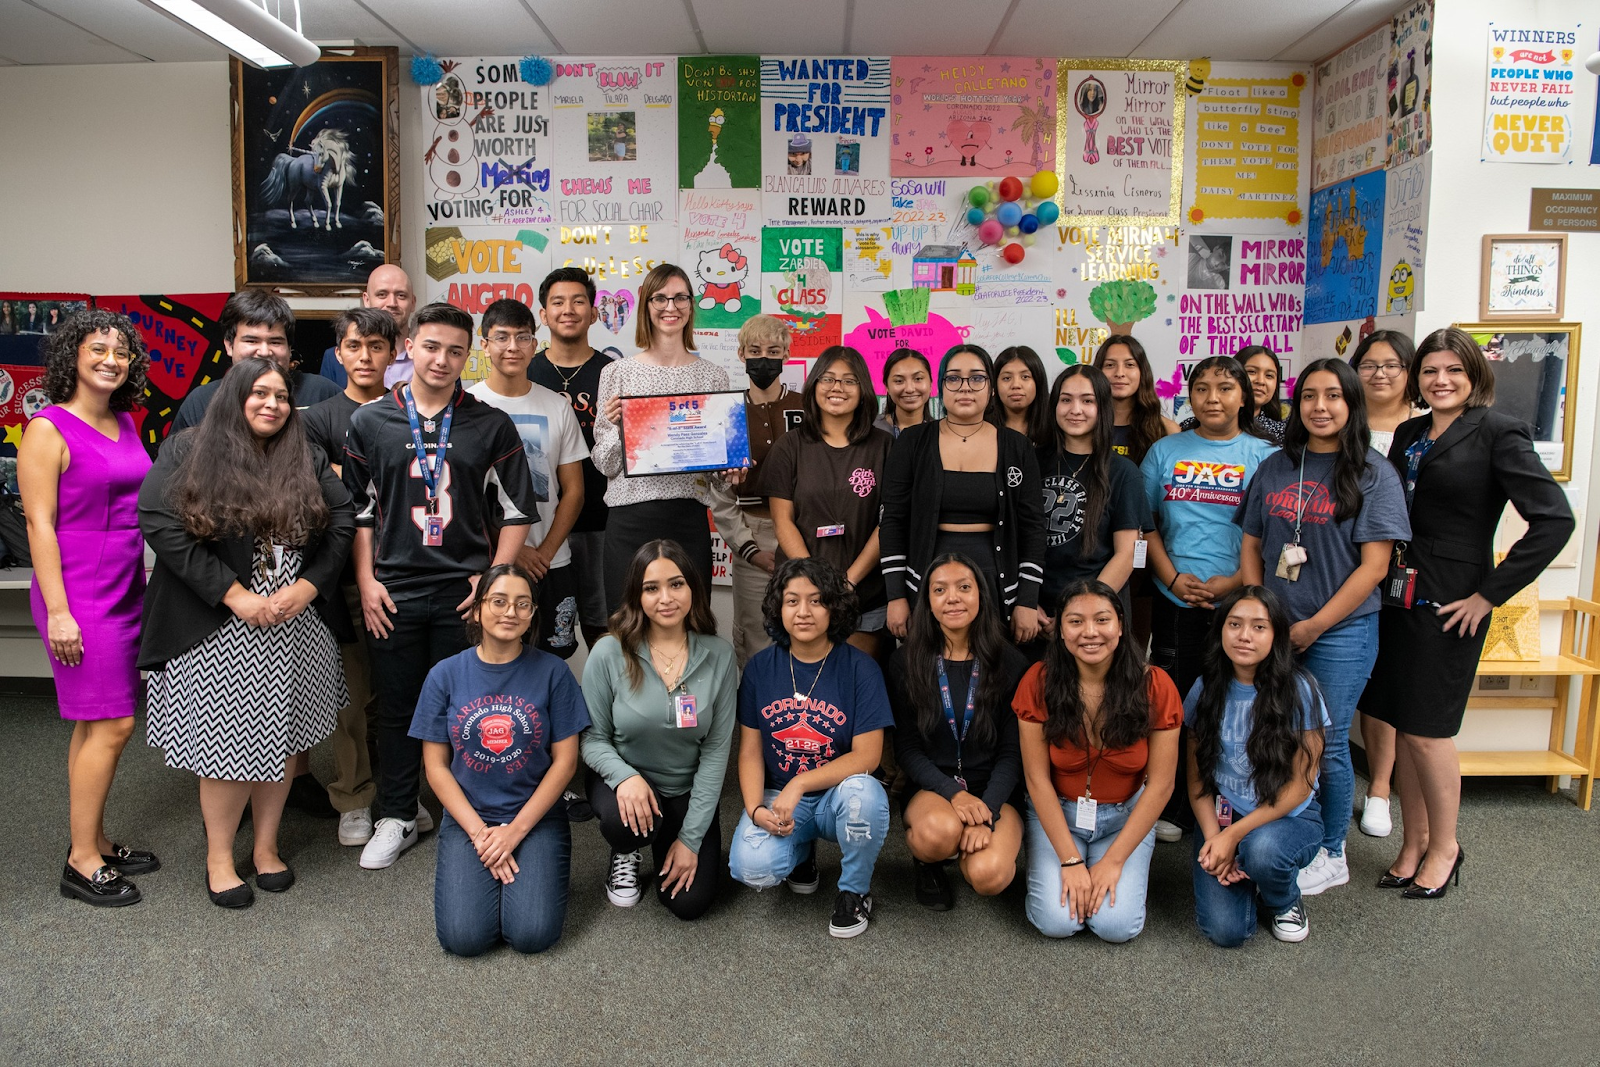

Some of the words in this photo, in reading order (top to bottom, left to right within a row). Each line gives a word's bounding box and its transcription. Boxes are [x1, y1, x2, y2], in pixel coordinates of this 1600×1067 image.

[1492, 29, 1576, 44] WINNERS
[1520, 51, 1532, 59] are
[1533, 53, 1547, 62] not
[556, 62, 596, 77] DON'T
[600, 72, 638, 87] BLOW
[645, 62, 665, 77] IT
[778, 59, 869, 81] WANTED
[941, 65, 986, 80] HEIDY
[1491, 68, 1540, 79] PEOPLE
[1543, 69, 1573, 80] WHO
[954, 77, 1028, 94] CALLETANO
[1124, 72, 1170, 95] Mirror
[1253, 87, 1275, 96] like
[1490, 82, 1537, 93] NEVER
[1541, 83, 1573, 94] FAIL
[473, 91, 538, 110] PEOPLE
[644, 95, 673, 105] DELGADO
[697, 90, 756, 102] HISTORIAN
[807, 82, 842, 105] FOR
[1490, 95, 1510, 106] but
[1510, 96, 1546, 109] people
[1548, 97, 1571, 107] who
[893, 76, 904, 146] VOTE
[985, 104, 1001, 112] 2022
[1123, 97, 1166, 113] Mirror
[1204, 104, 1260, 115] butterfly
[1267, 106, 1297, 118] sting
[475, 115, 505, 134] ARE
[513, 117, 549, 136] JUST
[774, 103, 885, 137] PRESIDENT
[1131, 116, 1144, 126] THE
[1150, 116, 1172, 127] WALL
[1207, 122, 1228, 131] like
[1493, 114, 1564, 132] NEVER
[1120, 126, 1141, 135] WHO
[1145, 127, 1153, 135] IS
[1157, 127, 1172, 136] THE
[474, 138, 536, 157] WORTH
[1106, 135, 1145, 156] BEST
[1148, 138, 1172, 157] VOTE
[1201, 141, 1232, 149] DONT
[1241, 142, 1270, 152] VOTE
[1277, 146, 1296, 154] FOR
[1493, 132, 1564, 155] QUIT
[1113, 159, 1123, 168] OF
[1242, 157, 1271, 165] VOTE
[1275, 162, 1296, 170] FOR
[628, 178, 652, 195] ME
[765, 175, 805, 193] BLANCA
[808, 178, 826, 194] LUIS
[832, 179, 885, 195] OLIVARES
[1124, 174, 1162, 198] Cisneros
[684, 193, 708, 210] Hello
[892, 197, 914, 208] Take
[1200, 187, 1234, 195] DAISY
[1238, 193, 1295, 201] MARTINEZ
[1552, 193, 1592, 201] MAXIMUM
[427, 199, 494, 221] VOTING
[500, 189, 533, 208] FOR
[561, 200, 588, 223] FOR
[593, 200, 628, 222] SOCIAL
[629, 201, 663, 222] CHAIR
[789, 198, 865, 216] REWARD
[1108, 206, 1128, 216] Class
[1545, 205, 1598, 214] OCCUPANCY
[689, 212, 728, 228] VOTE
[732, 213, 746, 230] 4
[1543, 218, 1553, 226] 68
[1557, 219, 1598, 227] PERSONS
[560, 224, 612, 245] DON'T
[629, 225, 648, 244] BE
[1058, 226, 1099, 245] VOTE
[1106, 226, 1164, 245] MIRNA
[1165, 227, 1179, 246] 4
[779, 239, 824, 255] VOTE
[892, 242, 920, 255] AWAY
[1085, 244, 1152, 263] SERVICE
[1241, 239, 1305, 259] MIRROR
[451, 239, 524, 274] VOTE
[779, 258, 824, 270] ZABDIEL
[1080, 262, 1160, 281] LEARNING
[1240, 263, 1305, 285] MIRROR
[1506, 265, 1543, 275] THINGS
[797, 274, 806, 287] 4
[777, 288, 826, 305] CLASS
[1501, 284, 1545, 298] Kindness
[1180, 294, 1202, 314] ON
[1204, 294, 1230, 314] THE
[1234, 293, 1265, 314] WALL
[1056, 309, 1078, 327] ILL
[1179, 316, 1203, 334] THE
[1208, 316, 1238, 335] BEST
[1239, 314, 1303, 333] SECRETARY
[121, 303, 198, 357] JOURNEY
[867, 328, 896, 339] VOTE
[901, 328, 934, 337] DAVID
[1055, 327, 1109, 347] NEVER
[895, 339, 910, 348] FOR
[1179, 336, 1197, 354] OF
[1207, 334, 1251, 354] THEM
[1262, 334, 1293, 352] ALL
[14, 375, 46, 415] SUCCESS
[669, 401, 676, 411] 5
[679, 400, 690, 410] of
[692, 400, 699, 410] 5
[852, 467, 874, 479] Girls
[1175, 465, 1241, 488] JAG
[410, 453, 453, 532] 3
[852, 482, 873, 497] Cry
[1044, 477, 1079, 491] CLASS
[1076, 491, 1087, 503] OF
[1169, 487, 1191, 500] 40th
[1189, 488, 1241, 505] Anniversary
[712, 552, 728, 562] ELP
[456, 694, 525, 723] ARIZONA'S
[761, 697, 847, 726] CORONADO
[461, 707, 489, 740] Coronado
[491, 704, 513, 713] High
[512, 710, 532, 735] School
[452, 725, 464, 751] FOR
[488, 727, 505, 735] JAG
[505, 703, 543, 774] GRADUATES
[786, 739, 820, 751] 21-22
[462, 751, 493, 773] JOBS
[474, 748, 522, 763] 2019-2020
